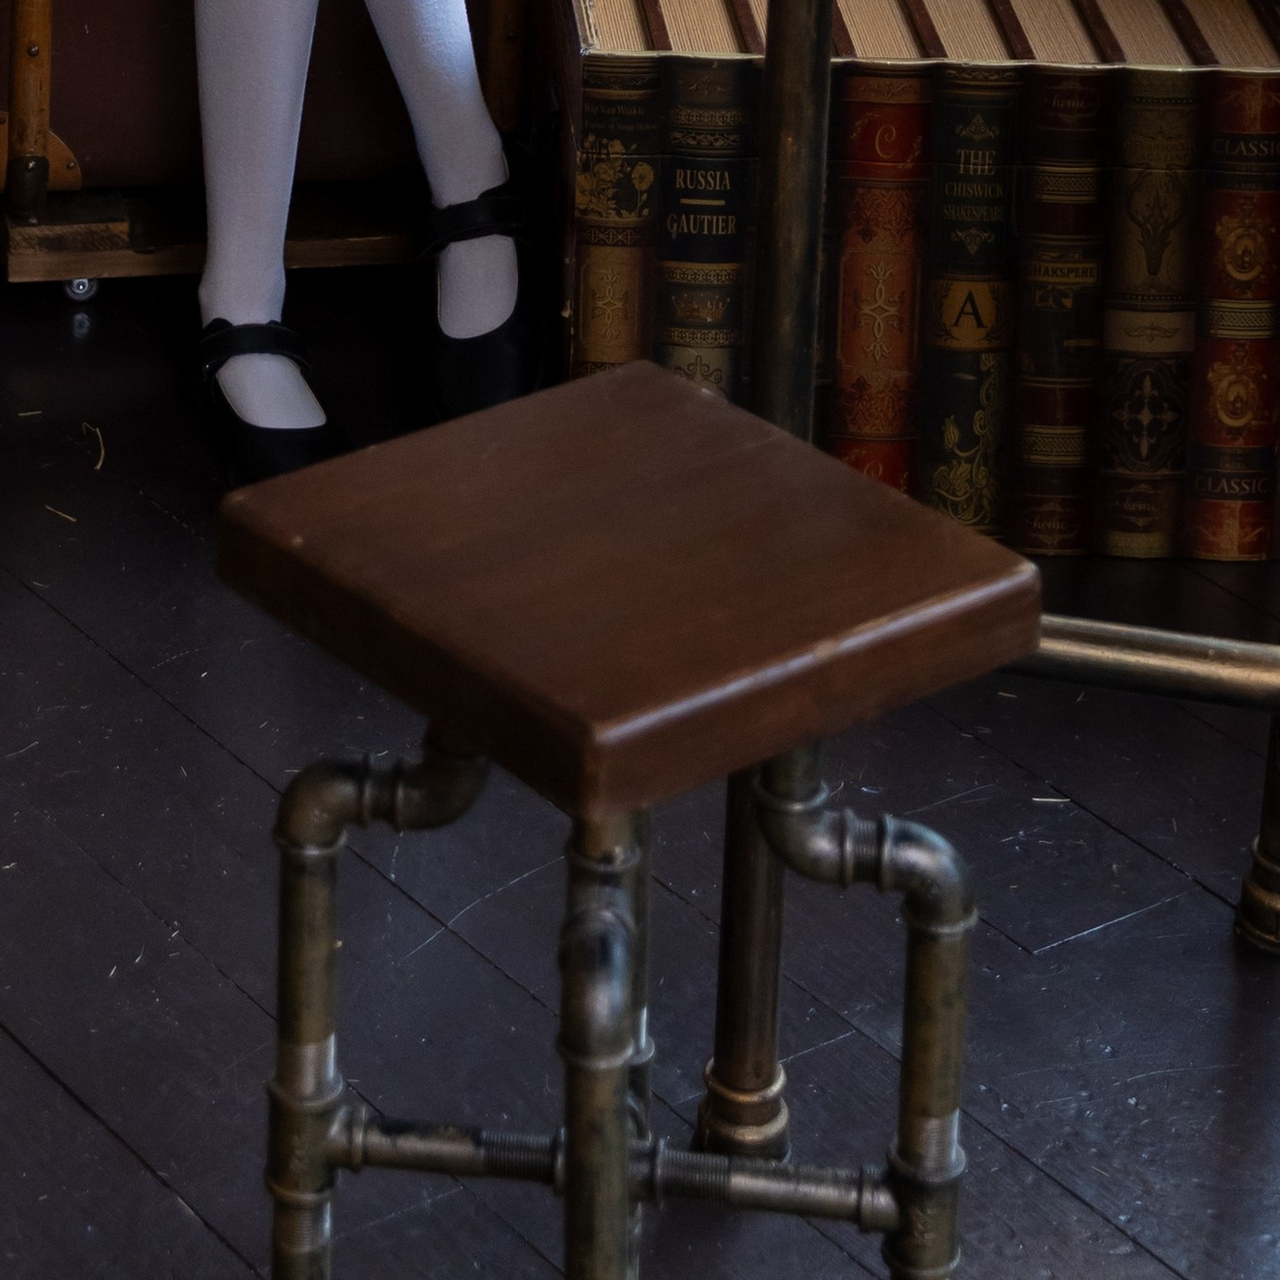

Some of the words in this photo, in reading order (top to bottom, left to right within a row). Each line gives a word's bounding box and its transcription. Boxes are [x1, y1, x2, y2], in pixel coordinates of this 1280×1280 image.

[956, 148, 997, 176] THE
[675, 168, 732, 191] RUSSIA
[944, 181, 1006, 199] CHISWICK
[666, 213, 738, 235] GAUTIER
[952, 290, 988, 329] A
[1193, 476, 1270, 494] CLASSIC
